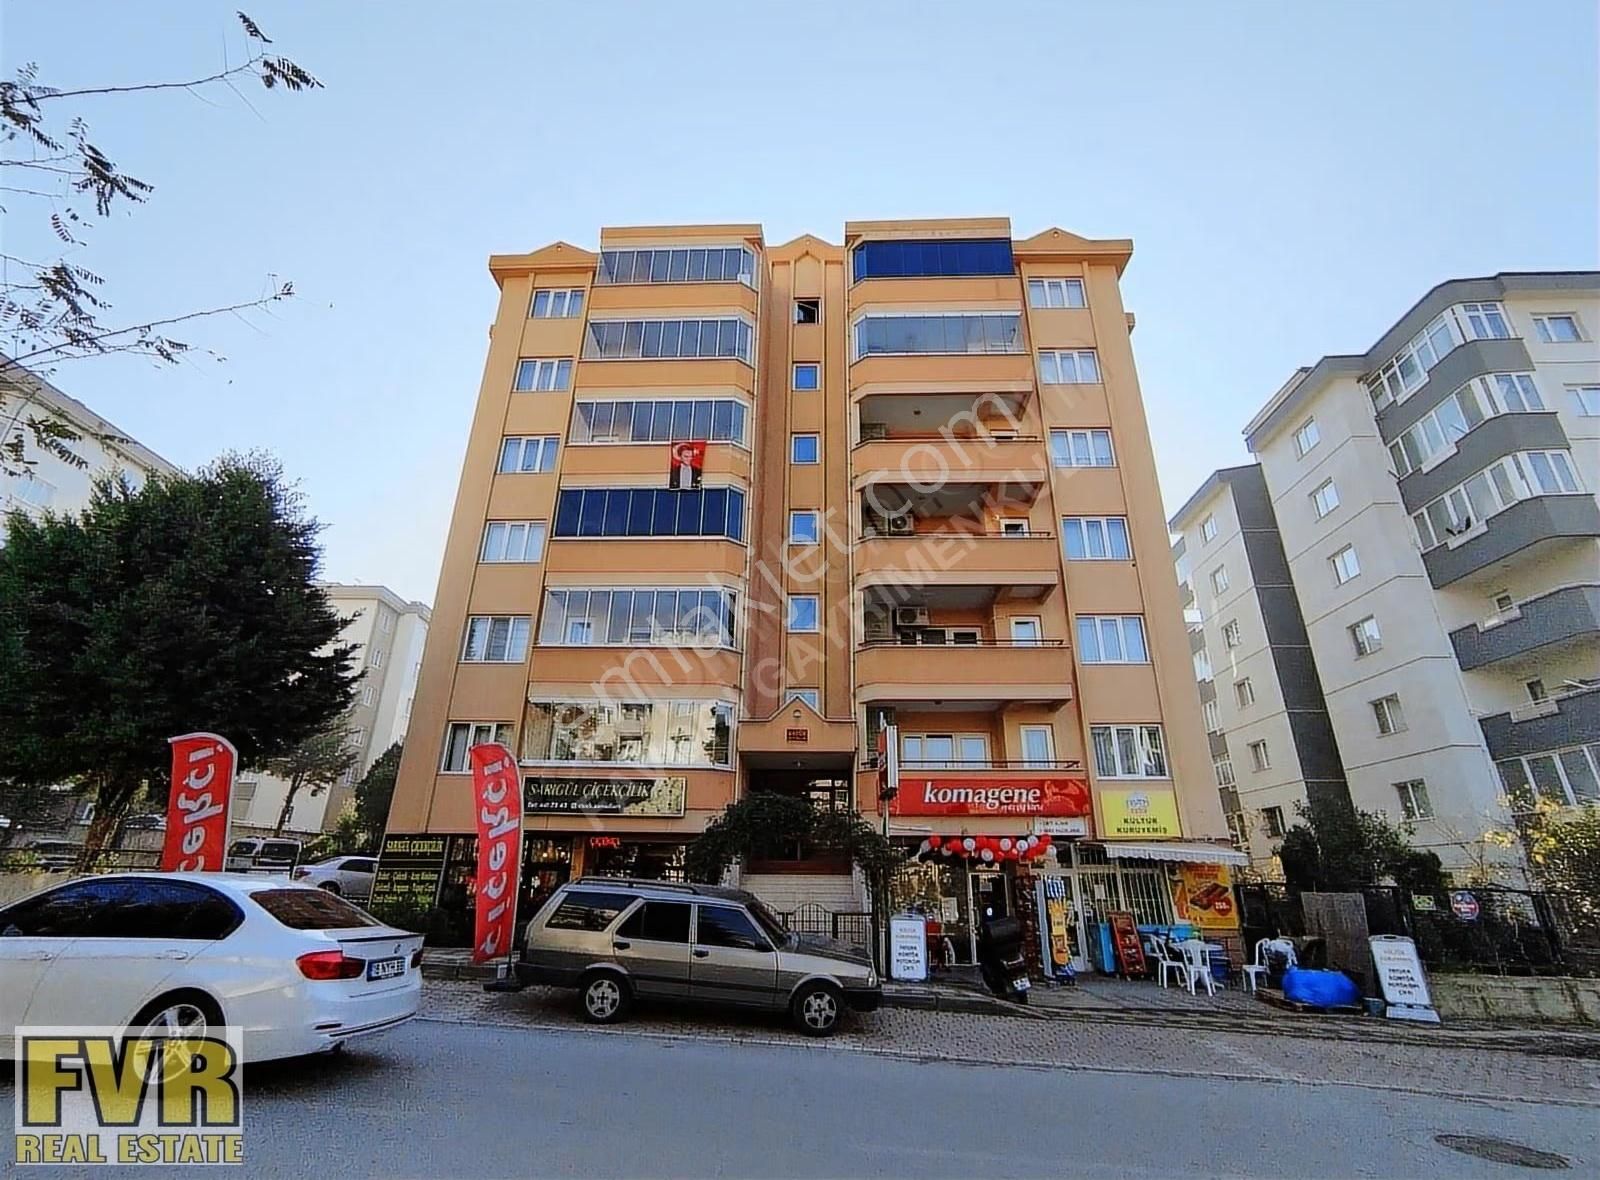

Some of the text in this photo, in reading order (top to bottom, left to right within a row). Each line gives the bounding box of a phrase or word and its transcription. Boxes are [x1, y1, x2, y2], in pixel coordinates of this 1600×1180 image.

[528, 781, 652, 799] SARIGÜL ÇİÇEKÇİLİK
[924, 781, 1041, 810] komagene
